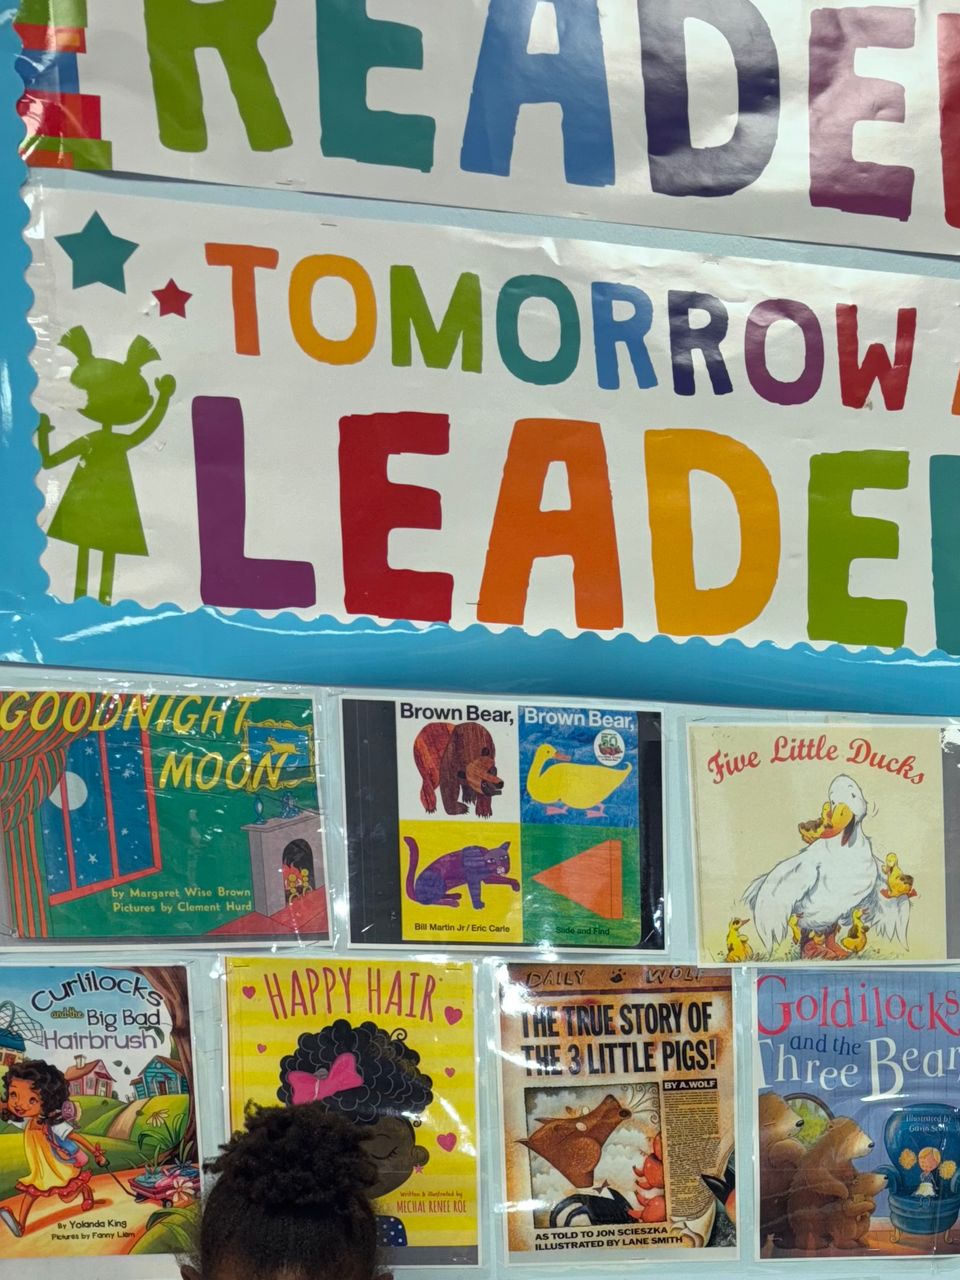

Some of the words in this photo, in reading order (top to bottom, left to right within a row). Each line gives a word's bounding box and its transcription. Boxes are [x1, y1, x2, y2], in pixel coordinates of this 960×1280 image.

[205, 242, 917, 411] TOMORROW
[0, 691, 261, 735] GOODNIGHT
[400, 702, 463, 721] Brown
[466, 704, 514, 726] Bear,
[524, 707, 586, 727] Brown
[589, 709, 635, 732] Bear,
[159, 751, 290, 791] MOON
[707, 749, 761, 784] Five
[770, 734, 839, 763] Little
[846, 737, 925, 785] Ducks
[111, 888, 125, 899] by
[130, 888, 180, 899] Margaret
[184, 887, 212, 897] Wise
[217, 886, 251, 897] Brown
[113, 902, 156, 912] Pictures
[160, 902, 174, 914] by
[177, 901, 221, 912] Clement
[226, 901, 252, 912] Hurd
[414, 922, 428, 932] Bill
[429, 923, 455, 932] Martin
[456, 923, 466, 933] Jr
[471, 924, 487, 933] Eric
[489, 924, 511, 933] Carle
[31, 970, 164, 1012] Curlilocks
[263, 966, 352, 1020] HAPPY
[367, 966, 437, 1022] HAIR
[87, 1008, 118, 1032] Big
[123, 1008, 161, 1026] Bad
[521, 1005, 560, 1039] THE
[562, 1004, 616, 1036] TRUE
[620, 1002, 683, 1035] STORY
[687, 1001, 713, 1033] OF
[44, 1030, 158, 1050] Hairbrush
[790, 1034, 828, 1053] and
[833, 1034, 862, 1056] the
[521, 1044, 563, 1077] THE
[568, 1044, 581, 1076] 3
[587, 1041, 657, 1075] LITTLE
[662, 1038, 716, 1071] PIGS!
[757, 1039, 858, 1090] Three
[664, 1081, 677, 1089] BY
[535, 1233, 550, 1241] AS
[551, 1231, 578, 1240] TOLD
[580, 1230, 594, 1239] TO
[595, 1229, 615, 1238] JON
[617, 1226, 668, 1236] SCIESZKA
[535, 1240, 604, 1251] ILLUSTRATED
[607, 1239, 621, 1247] BY
[623, 1237, 649, 1246] LANE
[651, 1236, 683, 1245] SMITH
